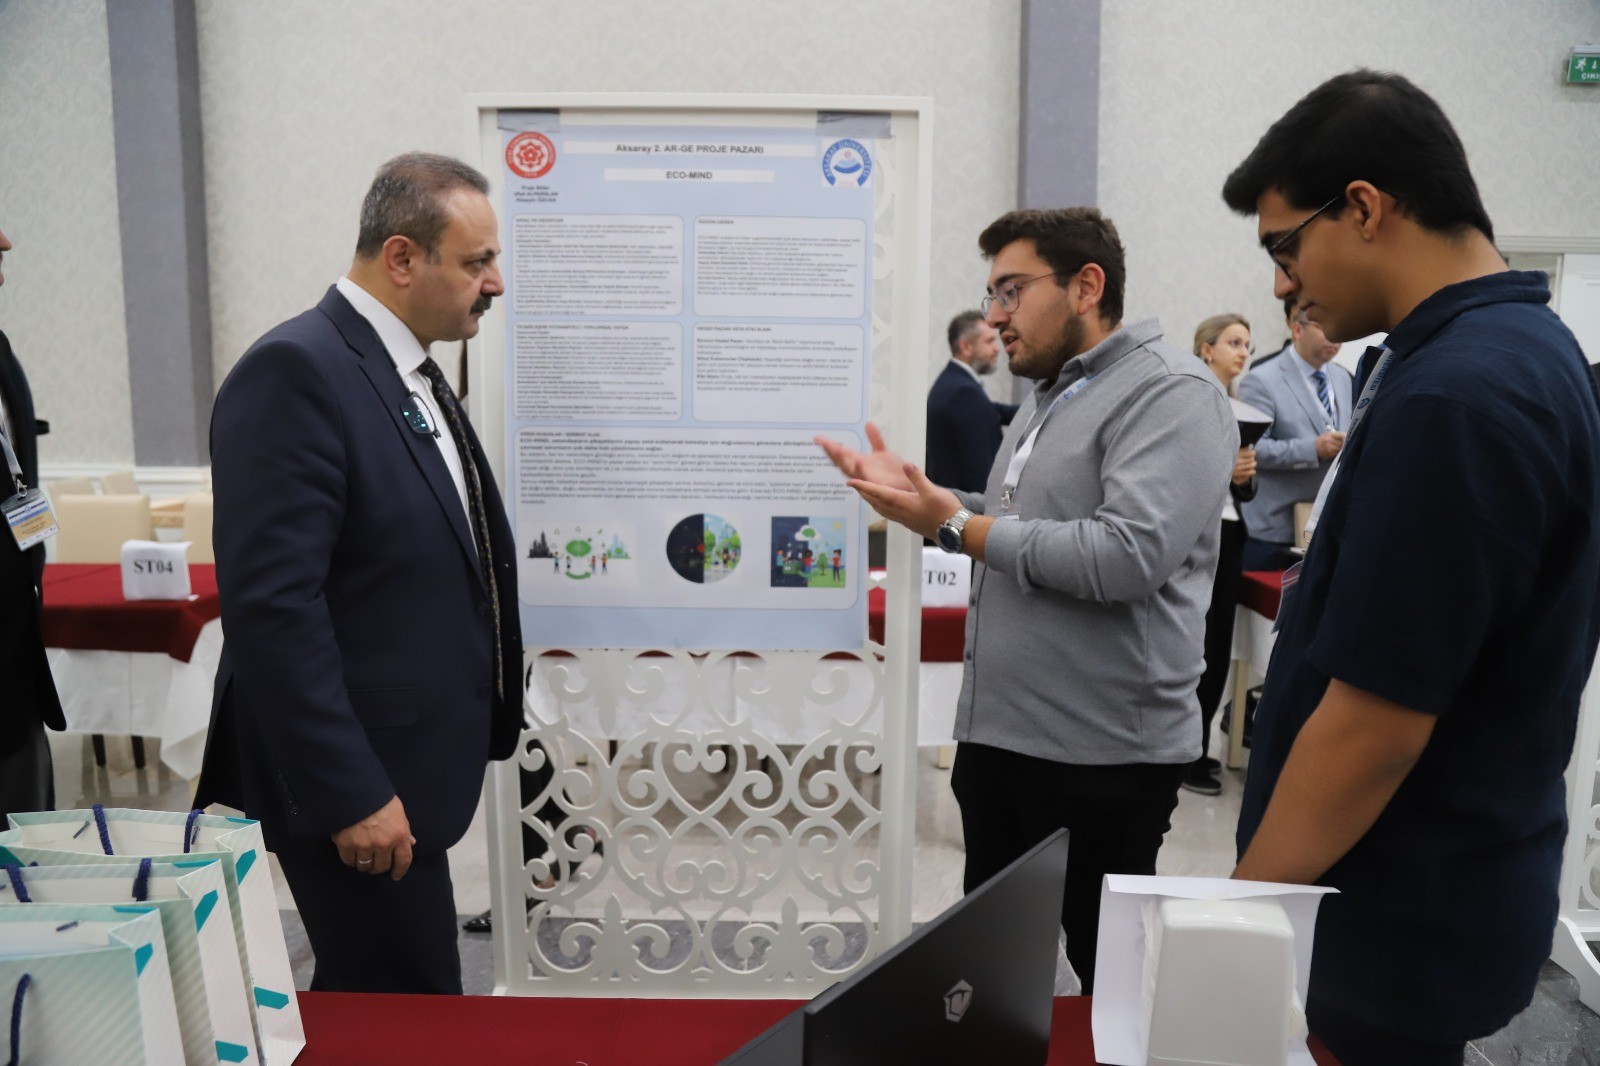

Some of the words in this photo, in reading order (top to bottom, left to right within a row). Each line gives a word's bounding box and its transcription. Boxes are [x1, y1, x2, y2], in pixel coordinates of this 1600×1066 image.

[616, 143, 651, 154] Aksaray
[654, 144, 661, 153] 2.
[664, 144, 694, 153] AR-GE
[696, 145, 727, 154] PROJE
[730, 145, 764, 154] PAZARI
[666, 170, 713, 180] ECO-MIND
[133, 560, 174, 575] ST04
[924, 570, 957, 586] T02
